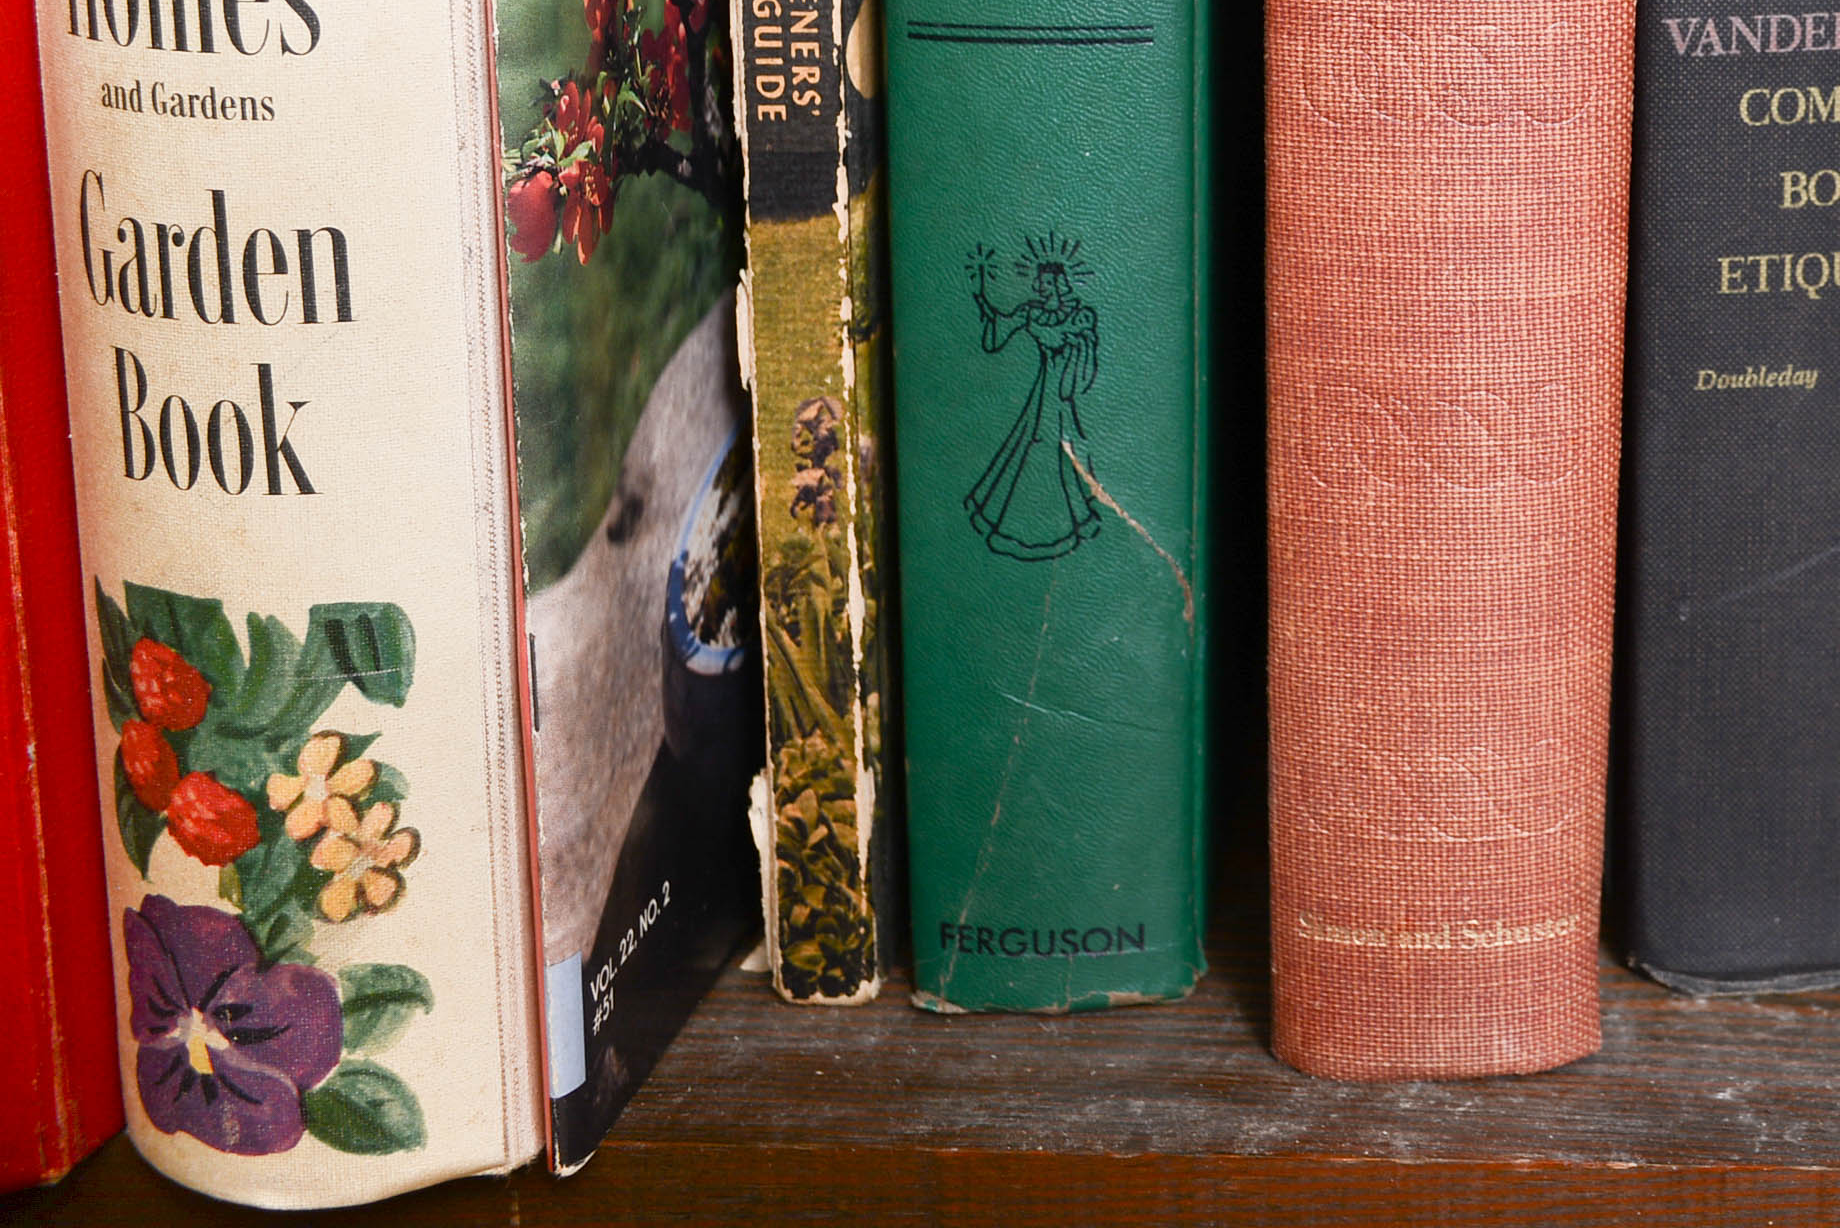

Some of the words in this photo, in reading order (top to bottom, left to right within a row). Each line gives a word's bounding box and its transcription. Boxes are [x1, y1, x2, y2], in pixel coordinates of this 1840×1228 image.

[100, 79, 144, 113] and
[152, 82, 275, 122] Gardens
[79, 169, 359, 325] Garden
[1695, 365, 1818, 391] Doubleday
[112, 346, 322, 497] Book
[590, 957, 617, 1002] VOL.
[620, 928, 637, 966] 22,
[639, 898, 660, 938] NO.
[662, 880, 671, 907] 2
[940, 924, 1145, 957] FERGUSON
[1299, 911, 1388, 946] Simon
[1399, 923, 1450, 949] and
[1460, 915, 1579, 949] Schuster
[592, 987, 614, 1036] #51
